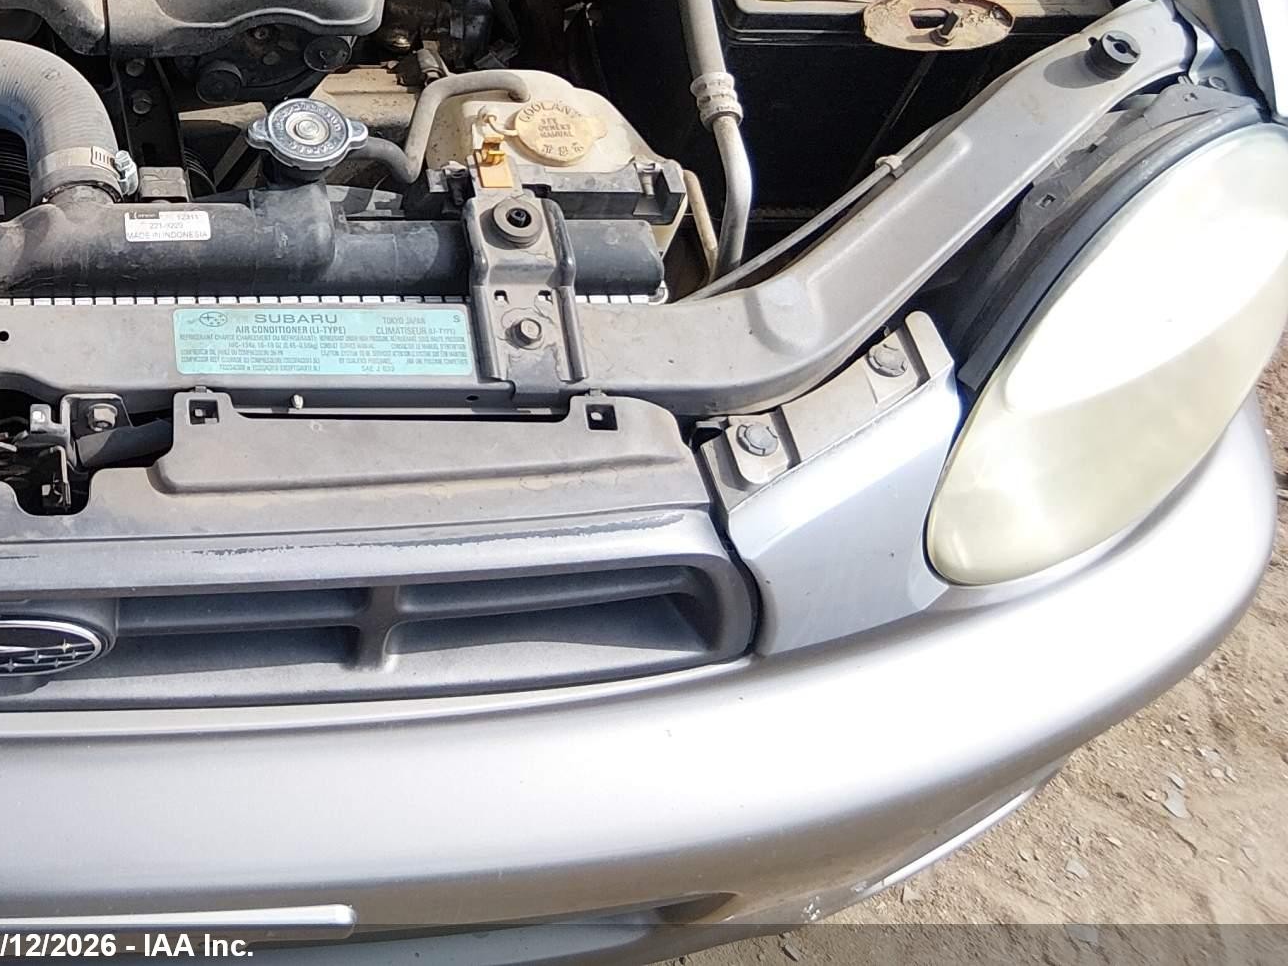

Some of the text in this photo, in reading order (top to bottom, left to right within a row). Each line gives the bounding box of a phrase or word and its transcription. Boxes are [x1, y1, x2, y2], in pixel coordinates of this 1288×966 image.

[518, 99, 582, 123] COOLANT
[162, 230, 208, 239] INDONESIA
[254, 314, 337, 324] SUBARU
[235, 325, 346, 335] AIR CONDITIONER (LI-TYPE)
[376, 327, 426, 335] CLIMATISEUR
